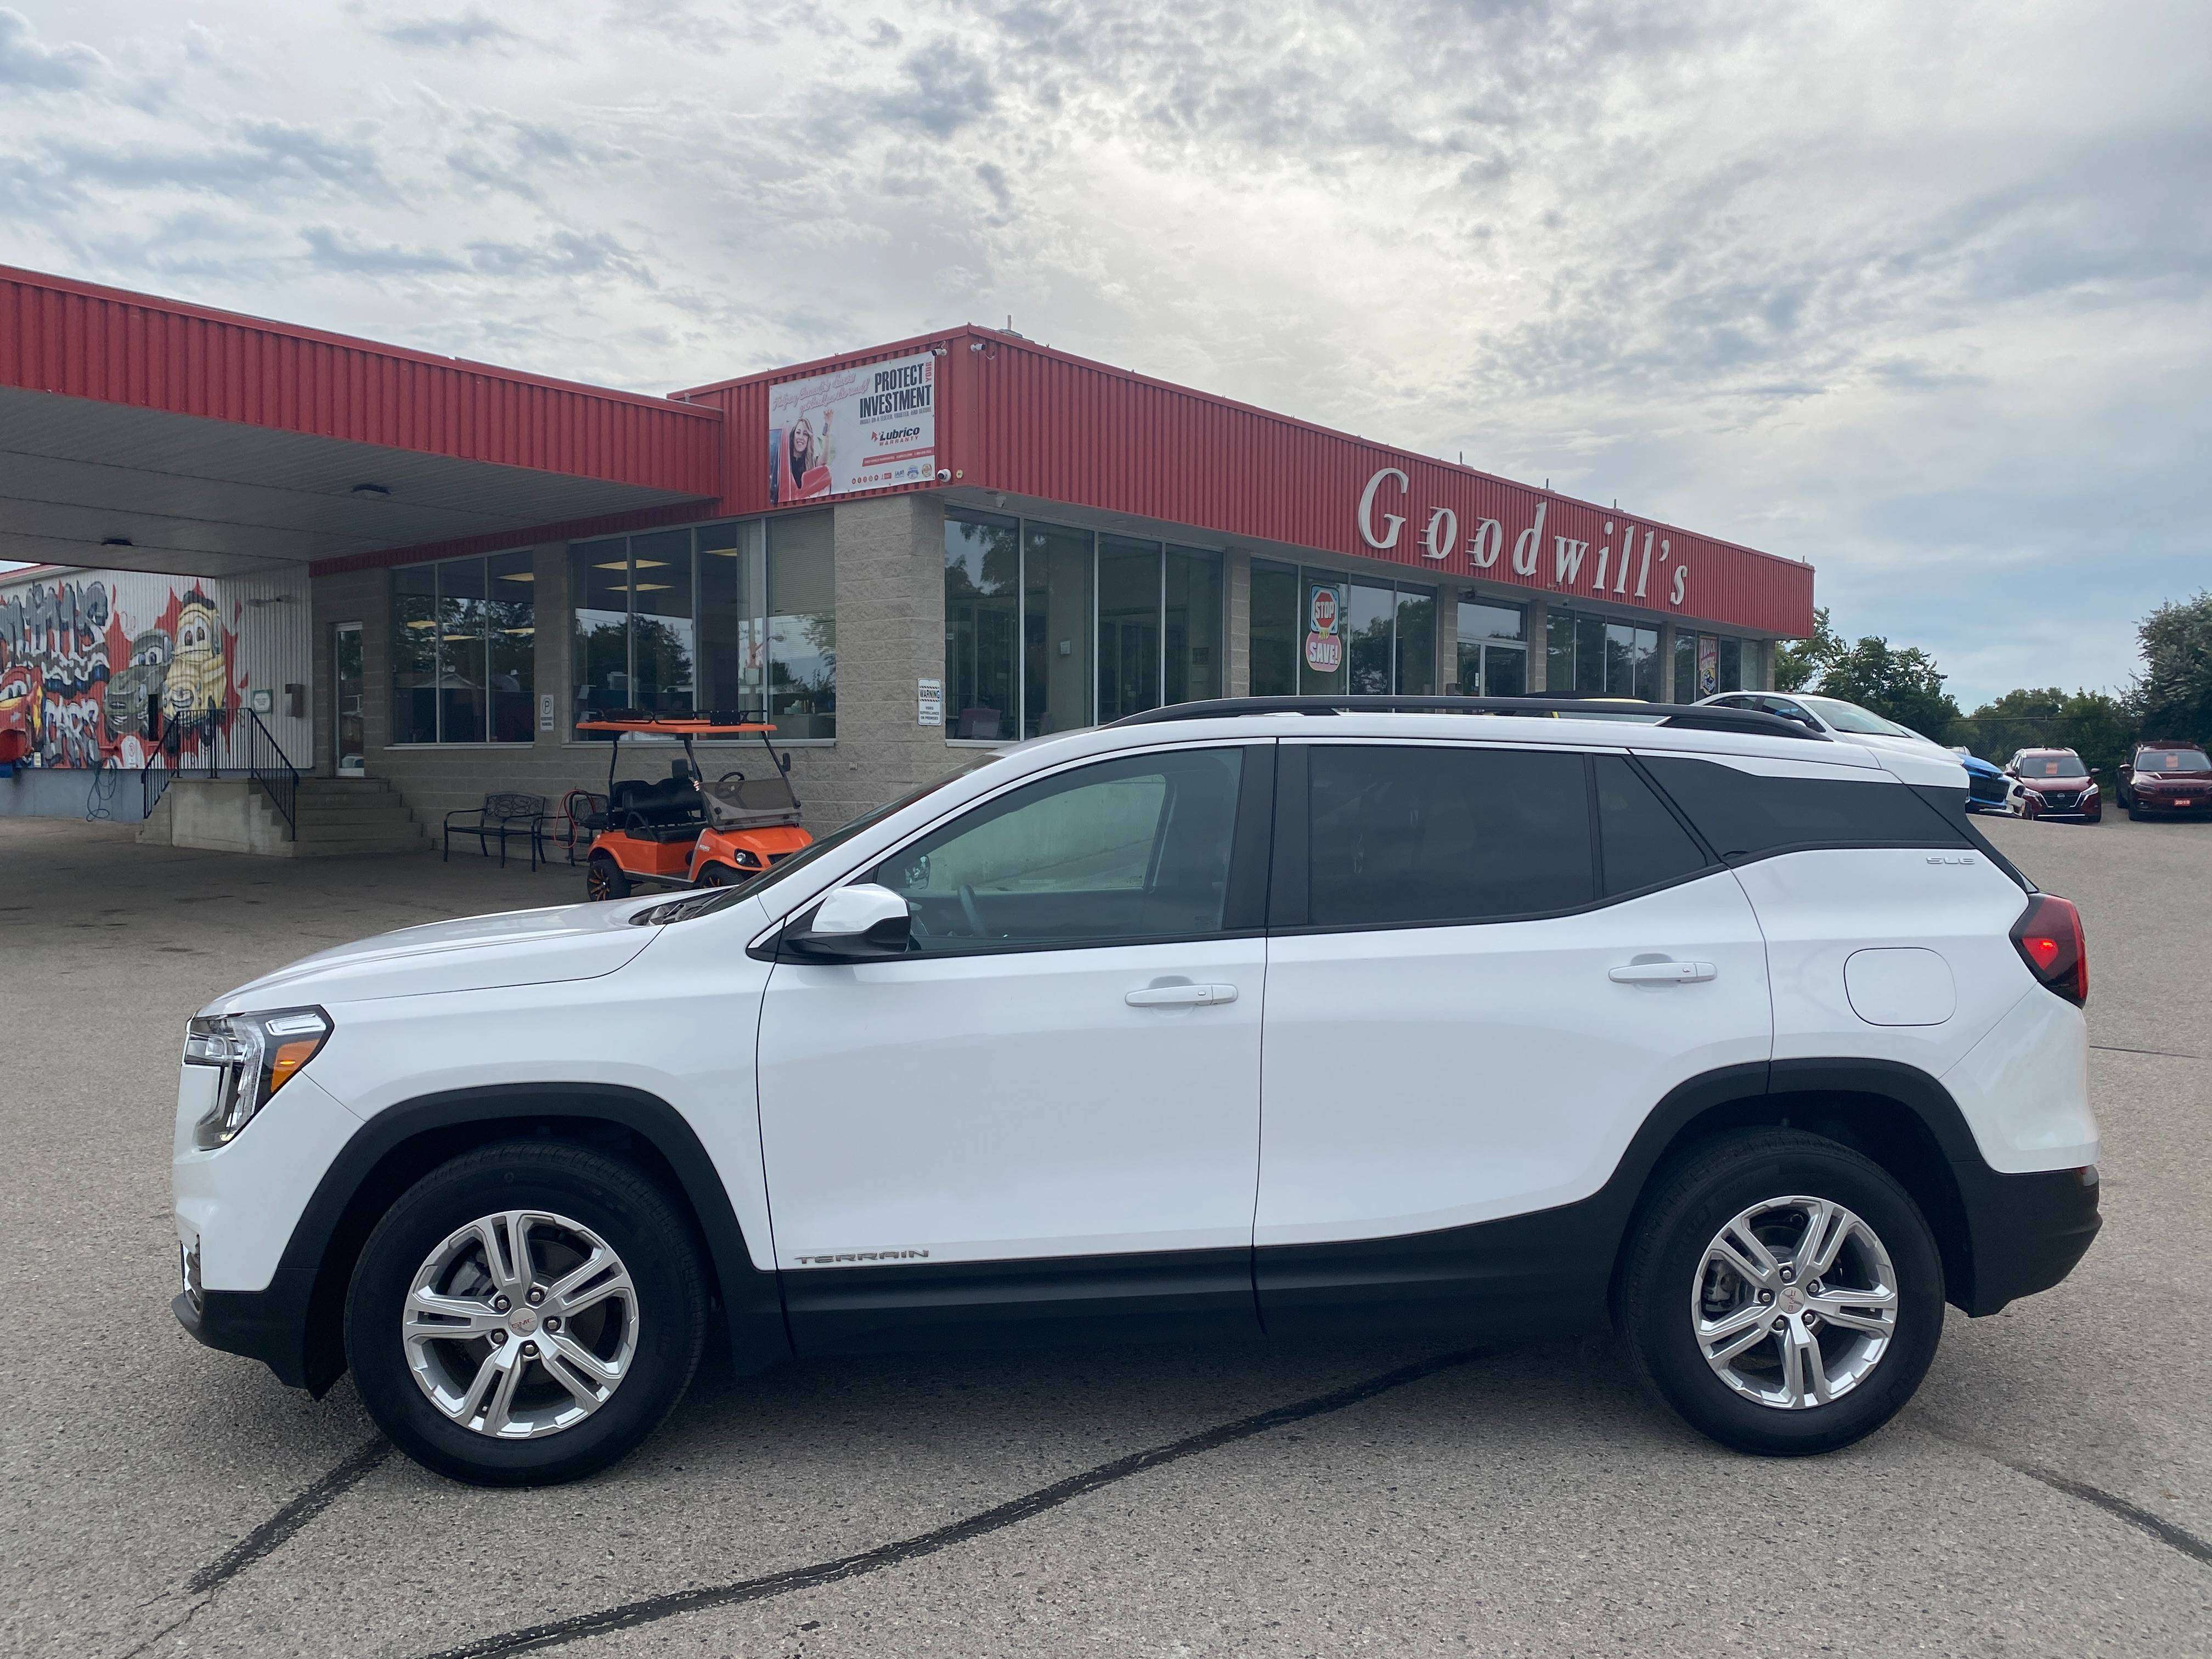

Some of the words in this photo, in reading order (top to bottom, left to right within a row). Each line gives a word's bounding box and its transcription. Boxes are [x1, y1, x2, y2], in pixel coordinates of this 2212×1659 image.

[874, 363, 924, 393] PROTECT
[860, 384, 932, 418] INVESTMENT
[879, 427, 920, 441] Lubrico
[879, 435, 919, 446] WARRANTY
[1358, 467, 1688, 606] Goodwill's
[1315, 601, 1335, 619] STOP
[1310, 642, 1338, 665] SAVE!
[1700, 639, 1716, 659] TRUCK
[920, 690, 940, 699] WARNING
[1926, 856, 1975, 865] SLE
[794, 1249, 929, 1264] TERRAIN
[1788, 1290, 1796, 1311] GMC
[511, 1317, 535, 1329] GMC
